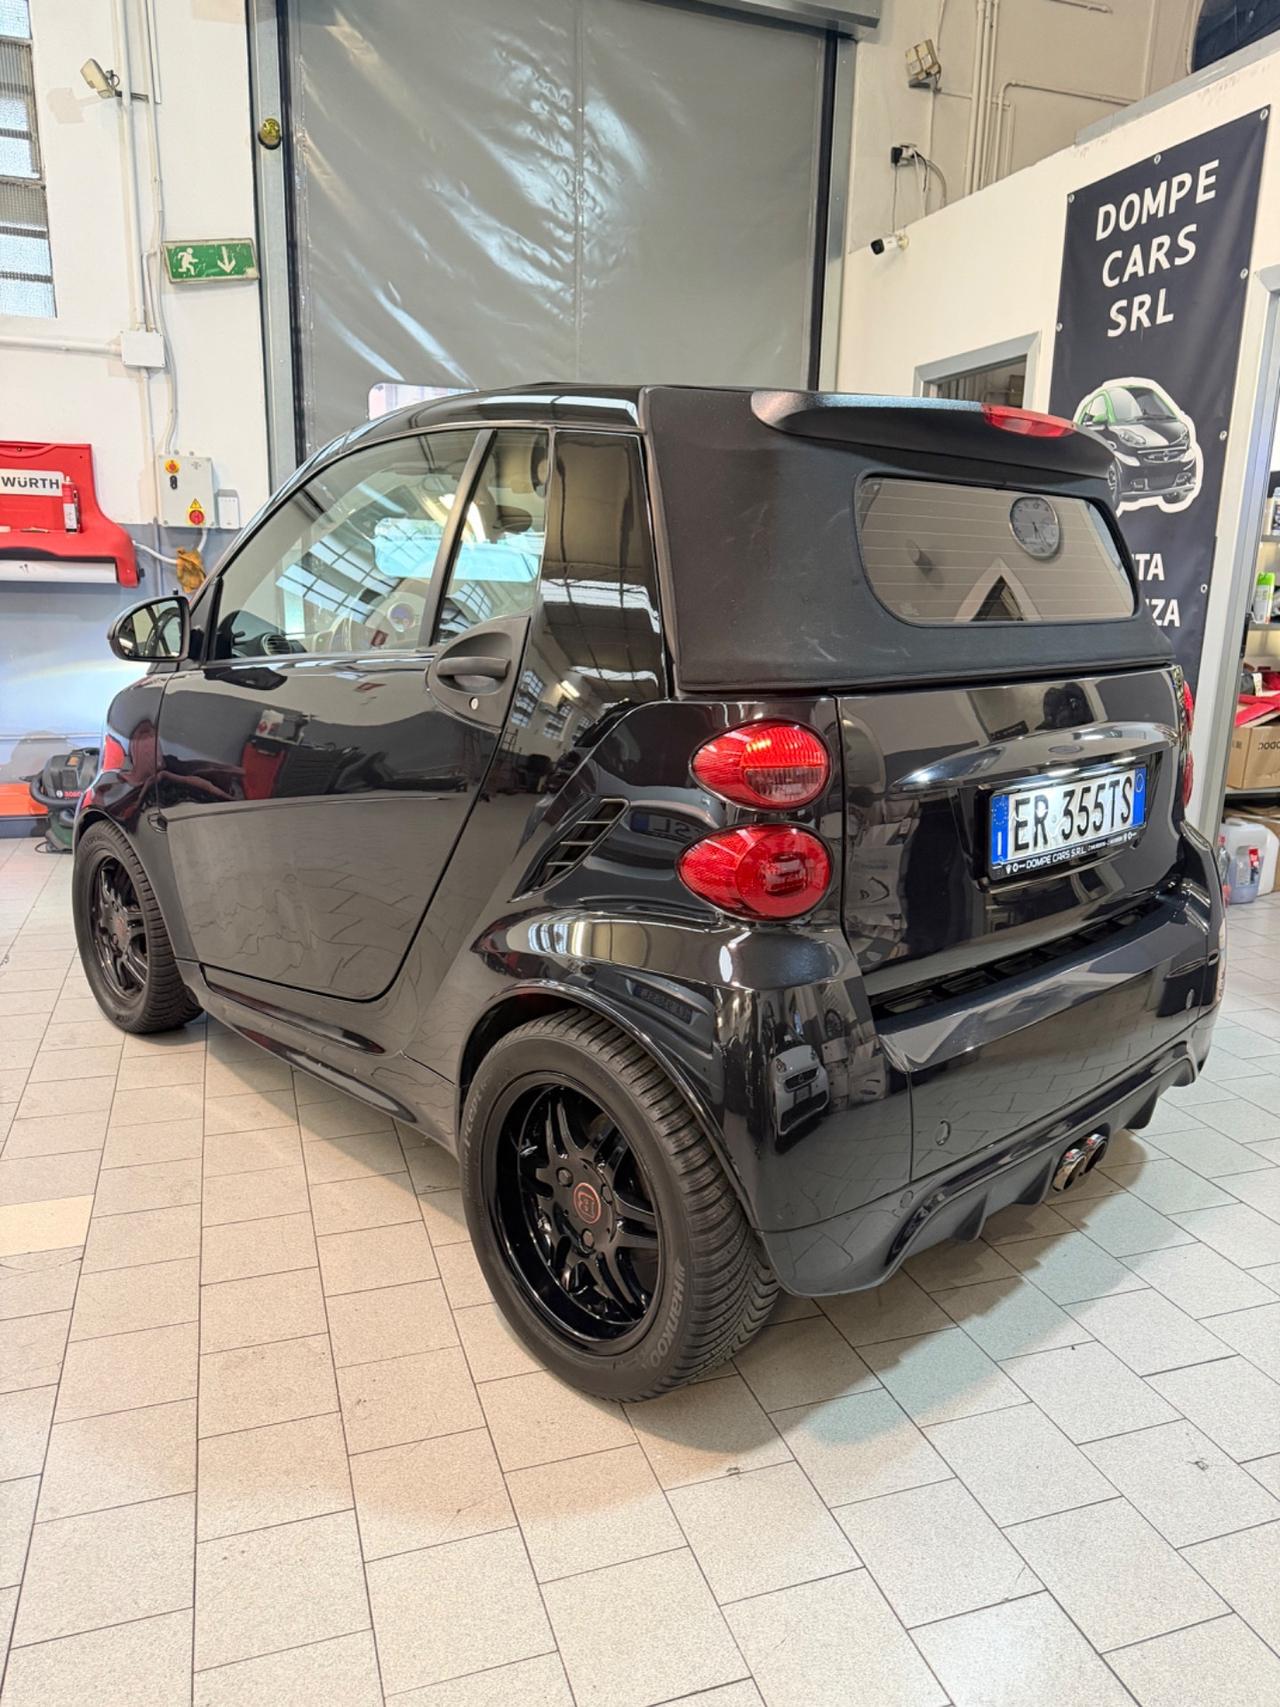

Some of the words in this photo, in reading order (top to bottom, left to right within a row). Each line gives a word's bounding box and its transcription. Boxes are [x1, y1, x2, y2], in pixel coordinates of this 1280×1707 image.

[1096, 159, 1219, 241] DOMPE
[1102, 224, 1197, 288] CARS
[1107, 288, 1174, 337] SRL
[1, 476, 59, 489] WÜRTH
[1131, 553, 1165, 581] TA
[1145, 598, 1181, 628] ZA
[1014, 794, 1049, 851] ER
[1061, 776, 1132, 840] 355TS
[1026, 855, 1051, 869] DOMPE
[1052, 850, 1071, 863] CARS
